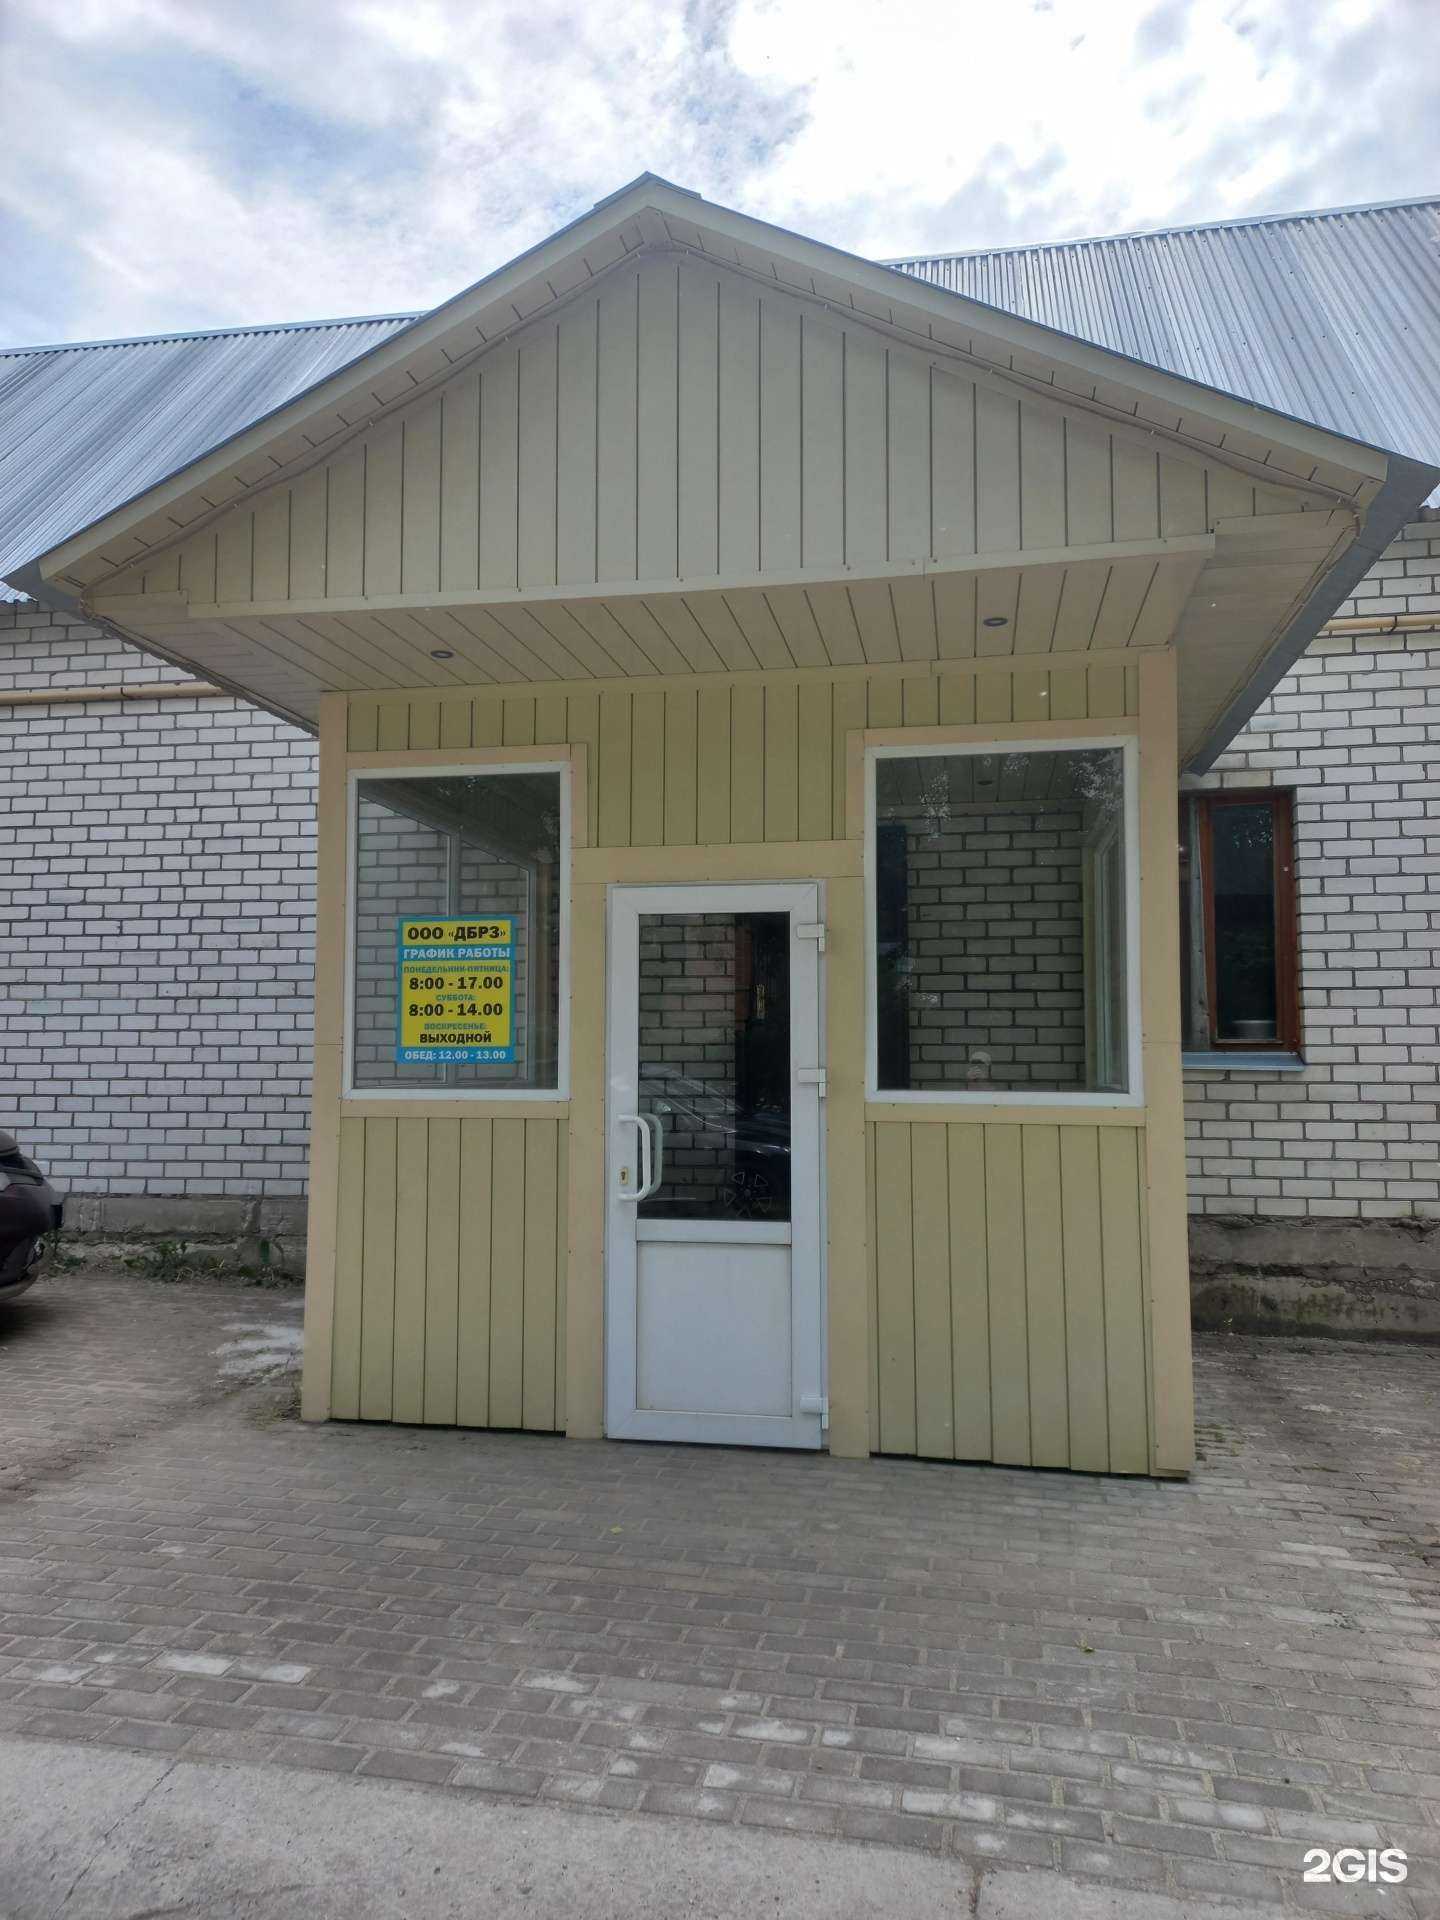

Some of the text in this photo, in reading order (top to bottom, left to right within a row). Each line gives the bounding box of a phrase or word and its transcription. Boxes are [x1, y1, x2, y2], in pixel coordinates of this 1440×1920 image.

[408, 926, 506, 941] ООО «ДБРЗ»
[404, 947, 510, 959] ГРАФИК РАБОТЫ
[409, 977, 444, 990] 8:00
[456, 976, 503, 989] 17.00
[408, 1004, 444, 1016] 8:00
[456, 1003, 503, 1016] 14.00
[420, 1030, 492, 1044] ВЫХОДНОЙ
[405, 1050, 436, 1060] ОБЕД:
[438, 1050, 468, 1060] 12.00
[476, 1050, 506, 1060] 13.00
